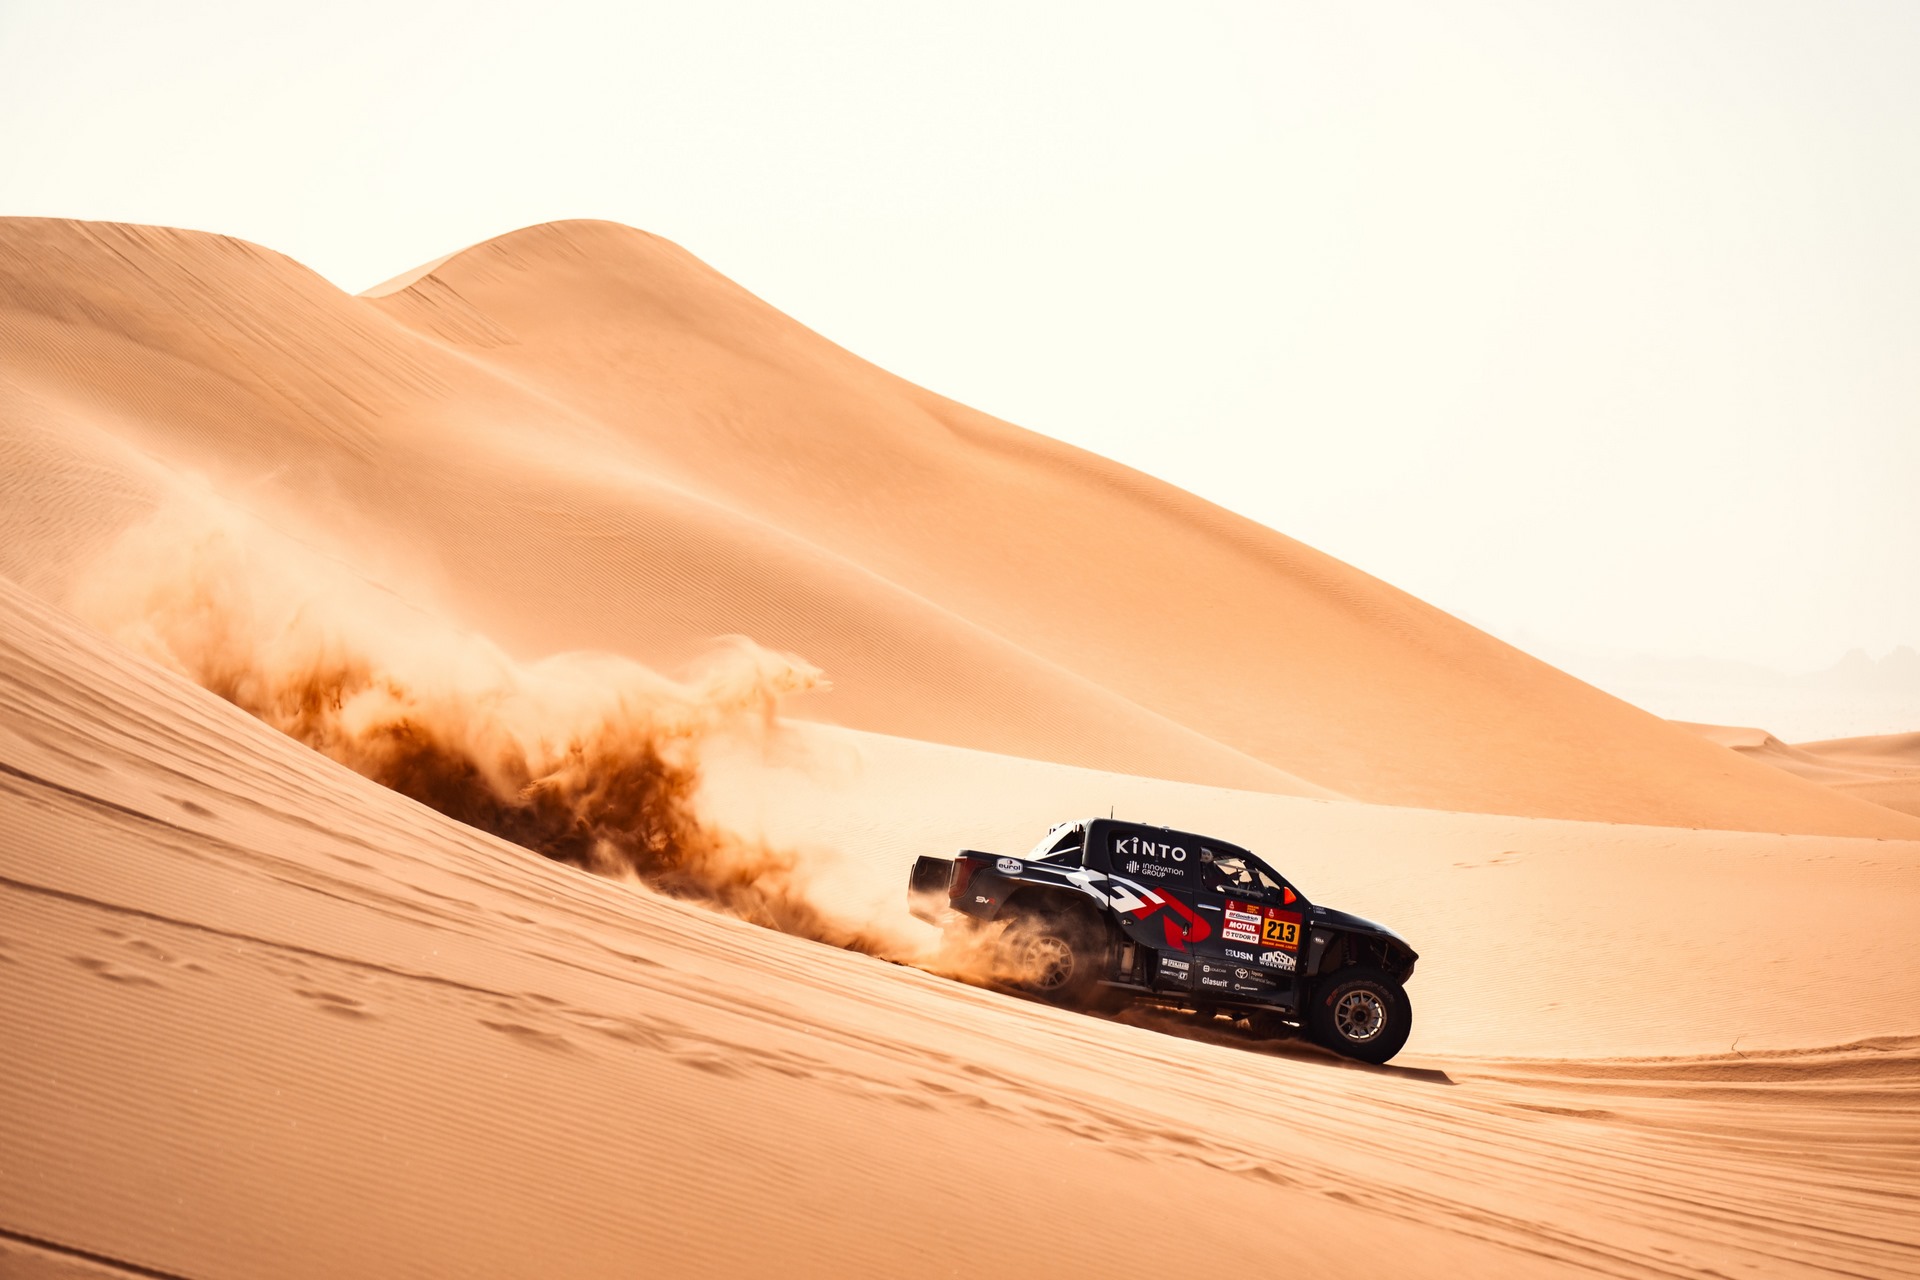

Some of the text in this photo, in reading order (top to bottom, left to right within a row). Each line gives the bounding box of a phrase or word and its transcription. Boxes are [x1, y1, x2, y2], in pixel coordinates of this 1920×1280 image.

[998, 863, 1021, 871] eurol
[1142, 863, 1184, 876] INNOVATION
[1142, 869, 1166, 878] GROUP
[1228, 921, 1256, 932] MOTUL
[1266, 920, 1296, 943] 213
[1231, 932, 1252, 941] TUDOR
[1233, 950, 1253, 962] USN
[1259, 950, 1297, 967] JONSSON
[1202, 977, 1228, 988] Glasurit
